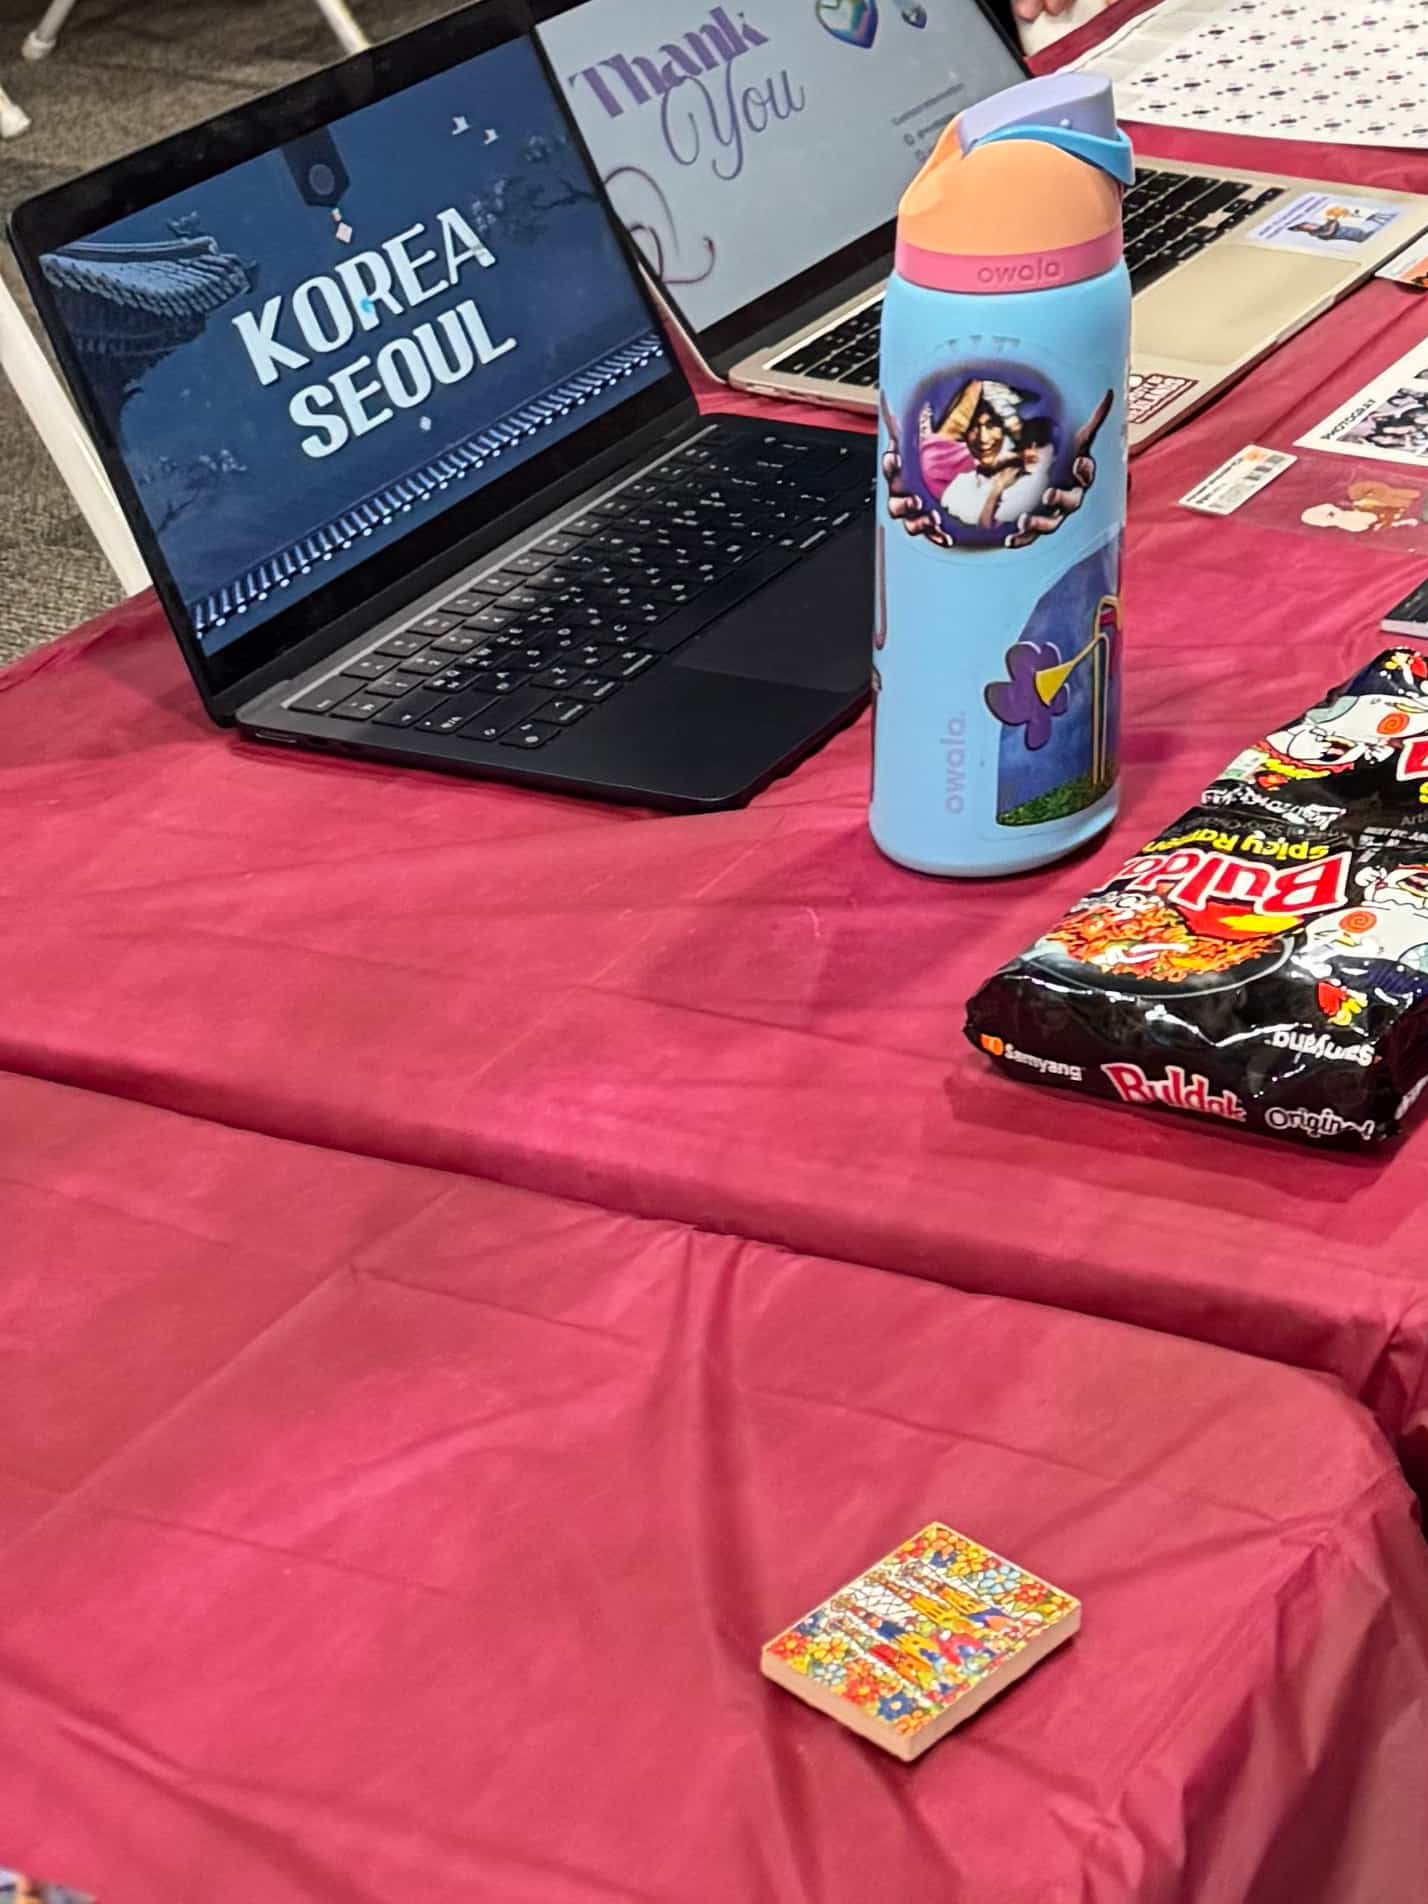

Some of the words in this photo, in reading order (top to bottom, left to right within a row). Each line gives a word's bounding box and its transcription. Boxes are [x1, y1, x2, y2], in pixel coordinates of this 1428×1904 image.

[569, 6, 772, 119] Thank
[661, 64, 805, 180] You
[231, 207, 496, 386] KOREA
[976, 256, 1062, 286] owala
[288, 299, 517, 458] SEOUL
[1244, 830, 1330, 860] Spicy
[1098, 848, 1352, 915] Bulda
[1004, 1044, 1084, 1081] Samyang
[1272, 1030, 1377, 1067] Samyang
[1101, 1062, 1246, 1123] Buldak
